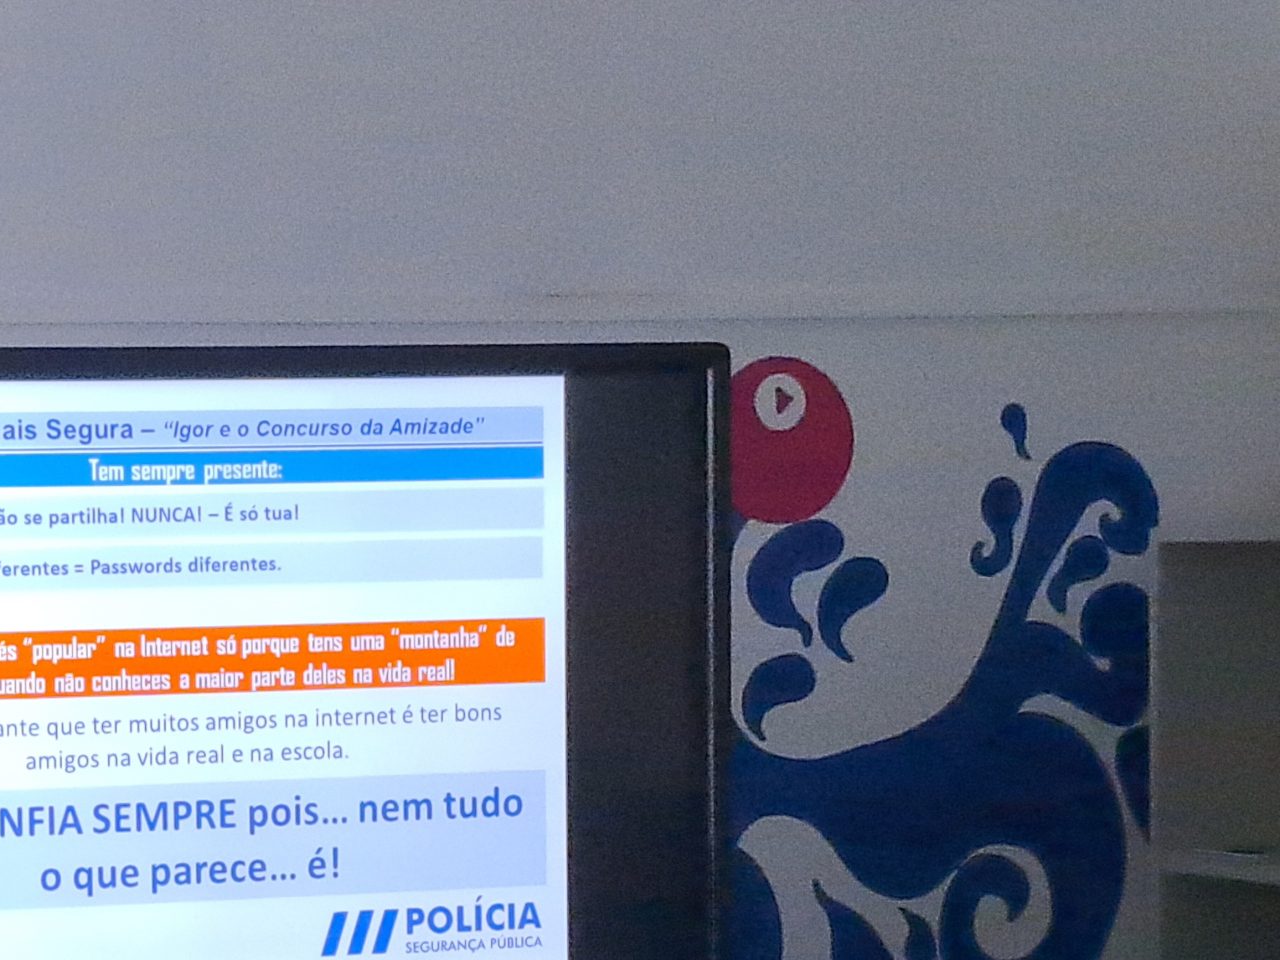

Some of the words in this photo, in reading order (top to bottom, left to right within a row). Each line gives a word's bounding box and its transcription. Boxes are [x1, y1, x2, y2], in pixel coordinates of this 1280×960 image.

[46, 418, 134, 446] Segura
[219, 424, 231, 438] e
[237, 423, 250, 438] o
[256, 419, 353, 437] Concurso
[359, 418, 384, 436] da
[88, 458, 125, 482] Tem
[130, 464, 196, 485] sempre
[203, 461, 284, 484] presente:
[23, 513, 43, 526] se
[48, 507, 125, 529] partilha!
[131, 505, 202, 524] NUNCA!
[224, 502, 233, 522] É
[239, 504, 259, 522] só
[263, 503, 299, 521] tua!
[90, 556, 183, 576] Passwords
[187, 556, 282, 573] diferentes.
[114, 641, 136, 659] na
[140, 634, 208, 658] Internet
[215, 634, 238, 656] só
[240, 636, 301, 660] porque
[307, 633, 344, 653] tens
[350, 634, 386, 652] uma
[495, 624, 516, 648] de
[53, 672, 87, 694] não
[92, 669, 171, 692] conheces
[178, 673, 191, 690] a
[194, 667, 245, 690] maior
[251, 669, 296, 692] parte
[302, 662, 347, 687] deles
[352, 667, 374, 685] na
[378, 659, 413, 684] vida
[417, 658, 456, 683] real!
[46, 720, 86, 741] que
[92, 717, 122, 735] ter
[129, 713, 200, 734] muitos
[205, 710, 278, 735] amigos
[284, 712, 308, 729] na
[315, 707, 397, 727] internet
[402, 704, 414, 724] é
[419, 706, 448, 724] ter
[454, 703, 503, 723] bons
[25, 750, 100, 774] amigos
[107, 752, 131, 768] na
[137, 745, 179, 767] vida
[186, 743, 224, 765] real
[231, 748, 244, 763] e
[250, 747, 274, 763] na
[280, 739, 349, 762] escola.
[92, 798, 237, 835] SEMPRE
[248, 794, 348, 836] pois...
[359, 797, 433, 823] nem
[443, 785, 523, 820] tudo
[40, 867, 62, 892] o
[73, 864, 140, 898] que
[151, 858, 297, 895] parece...
[307, 846, 339, 880] é!
[406, 895, 542, 935] POLÍCIA
[405, 939, 486, 954] SEGURANÇA
[490, 935, 543, 949] PÚBLICA
